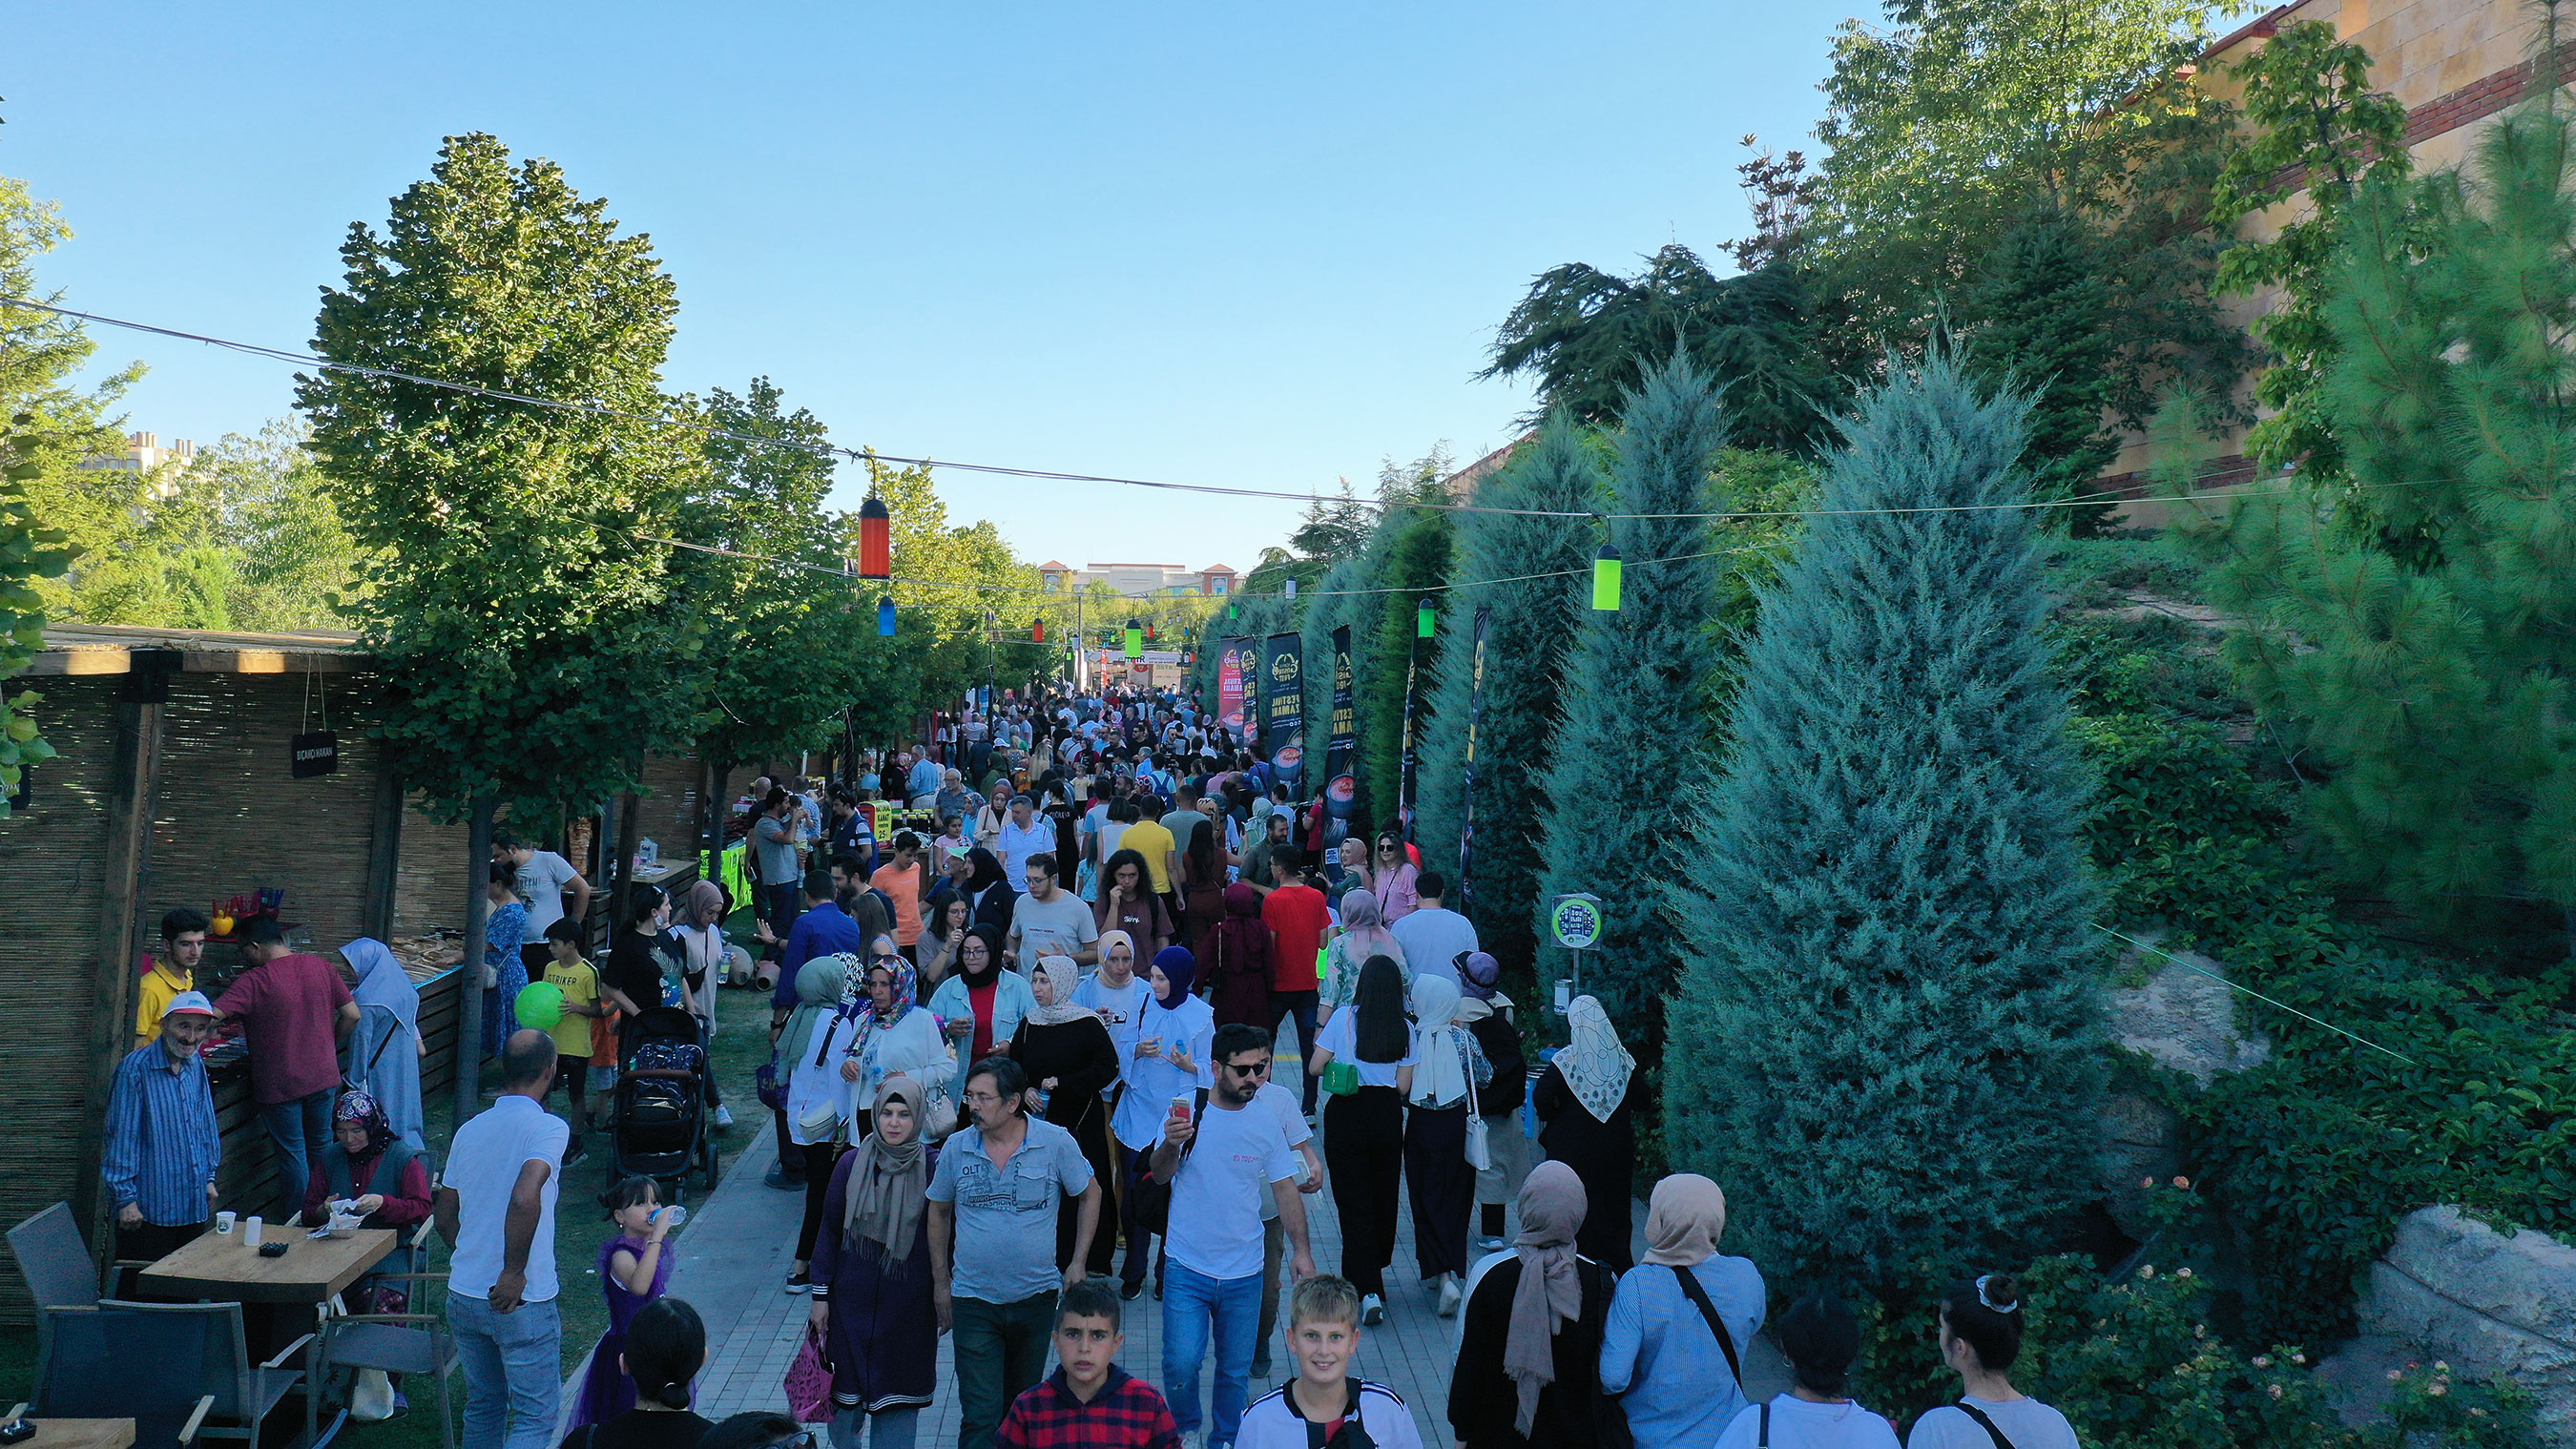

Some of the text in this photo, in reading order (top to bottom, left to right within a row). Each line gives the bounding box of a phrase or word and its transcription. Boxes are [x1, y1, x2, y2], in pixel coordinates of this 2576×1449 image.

[315, 747, 333, 758] HAKAN
[548, 974, 577, 986] STRIKER
[962, 1164, 981, 1176] QLT
